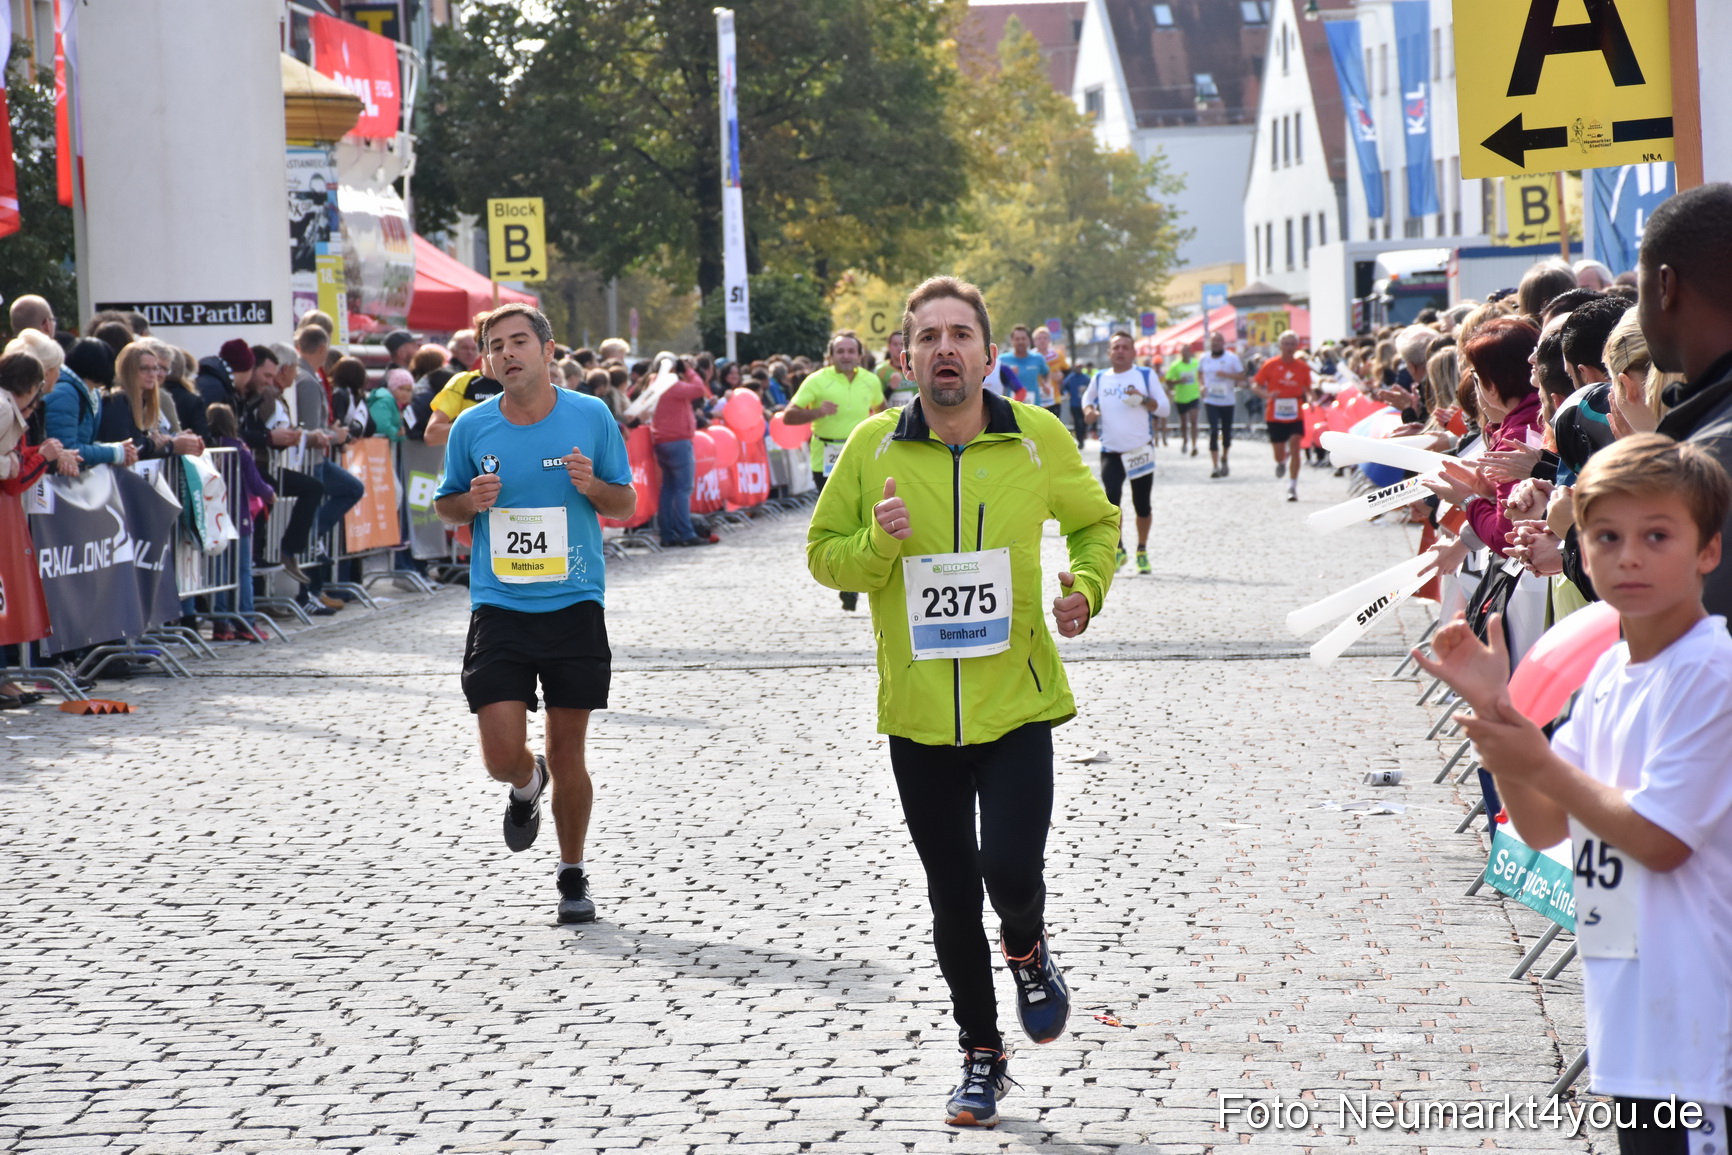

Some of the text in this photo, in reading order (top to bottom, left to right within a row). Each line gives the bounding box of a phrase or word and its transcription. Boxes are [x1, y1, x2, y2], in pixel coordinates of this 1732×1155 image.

[1506, 0, 1646, 97] A
[494, 202, 537, 217] Block
[1521, 185, 1550, 226] B
[504, 224, 531, 263] B
[870, 312, 886, 334] C
[1367, 484, 1405, 503] swn
[507, 531, 548, 555] 254
[39, 537, 112, 579] RAIL.ONE
[511, 561, 545, 571] Matthias
[943, 562, 979, 573] BOCK
[922, 583, 997, 618] 2375
[1356, 595, 1389, 625] swn
[940, 626, 987, 640] Bernhard
